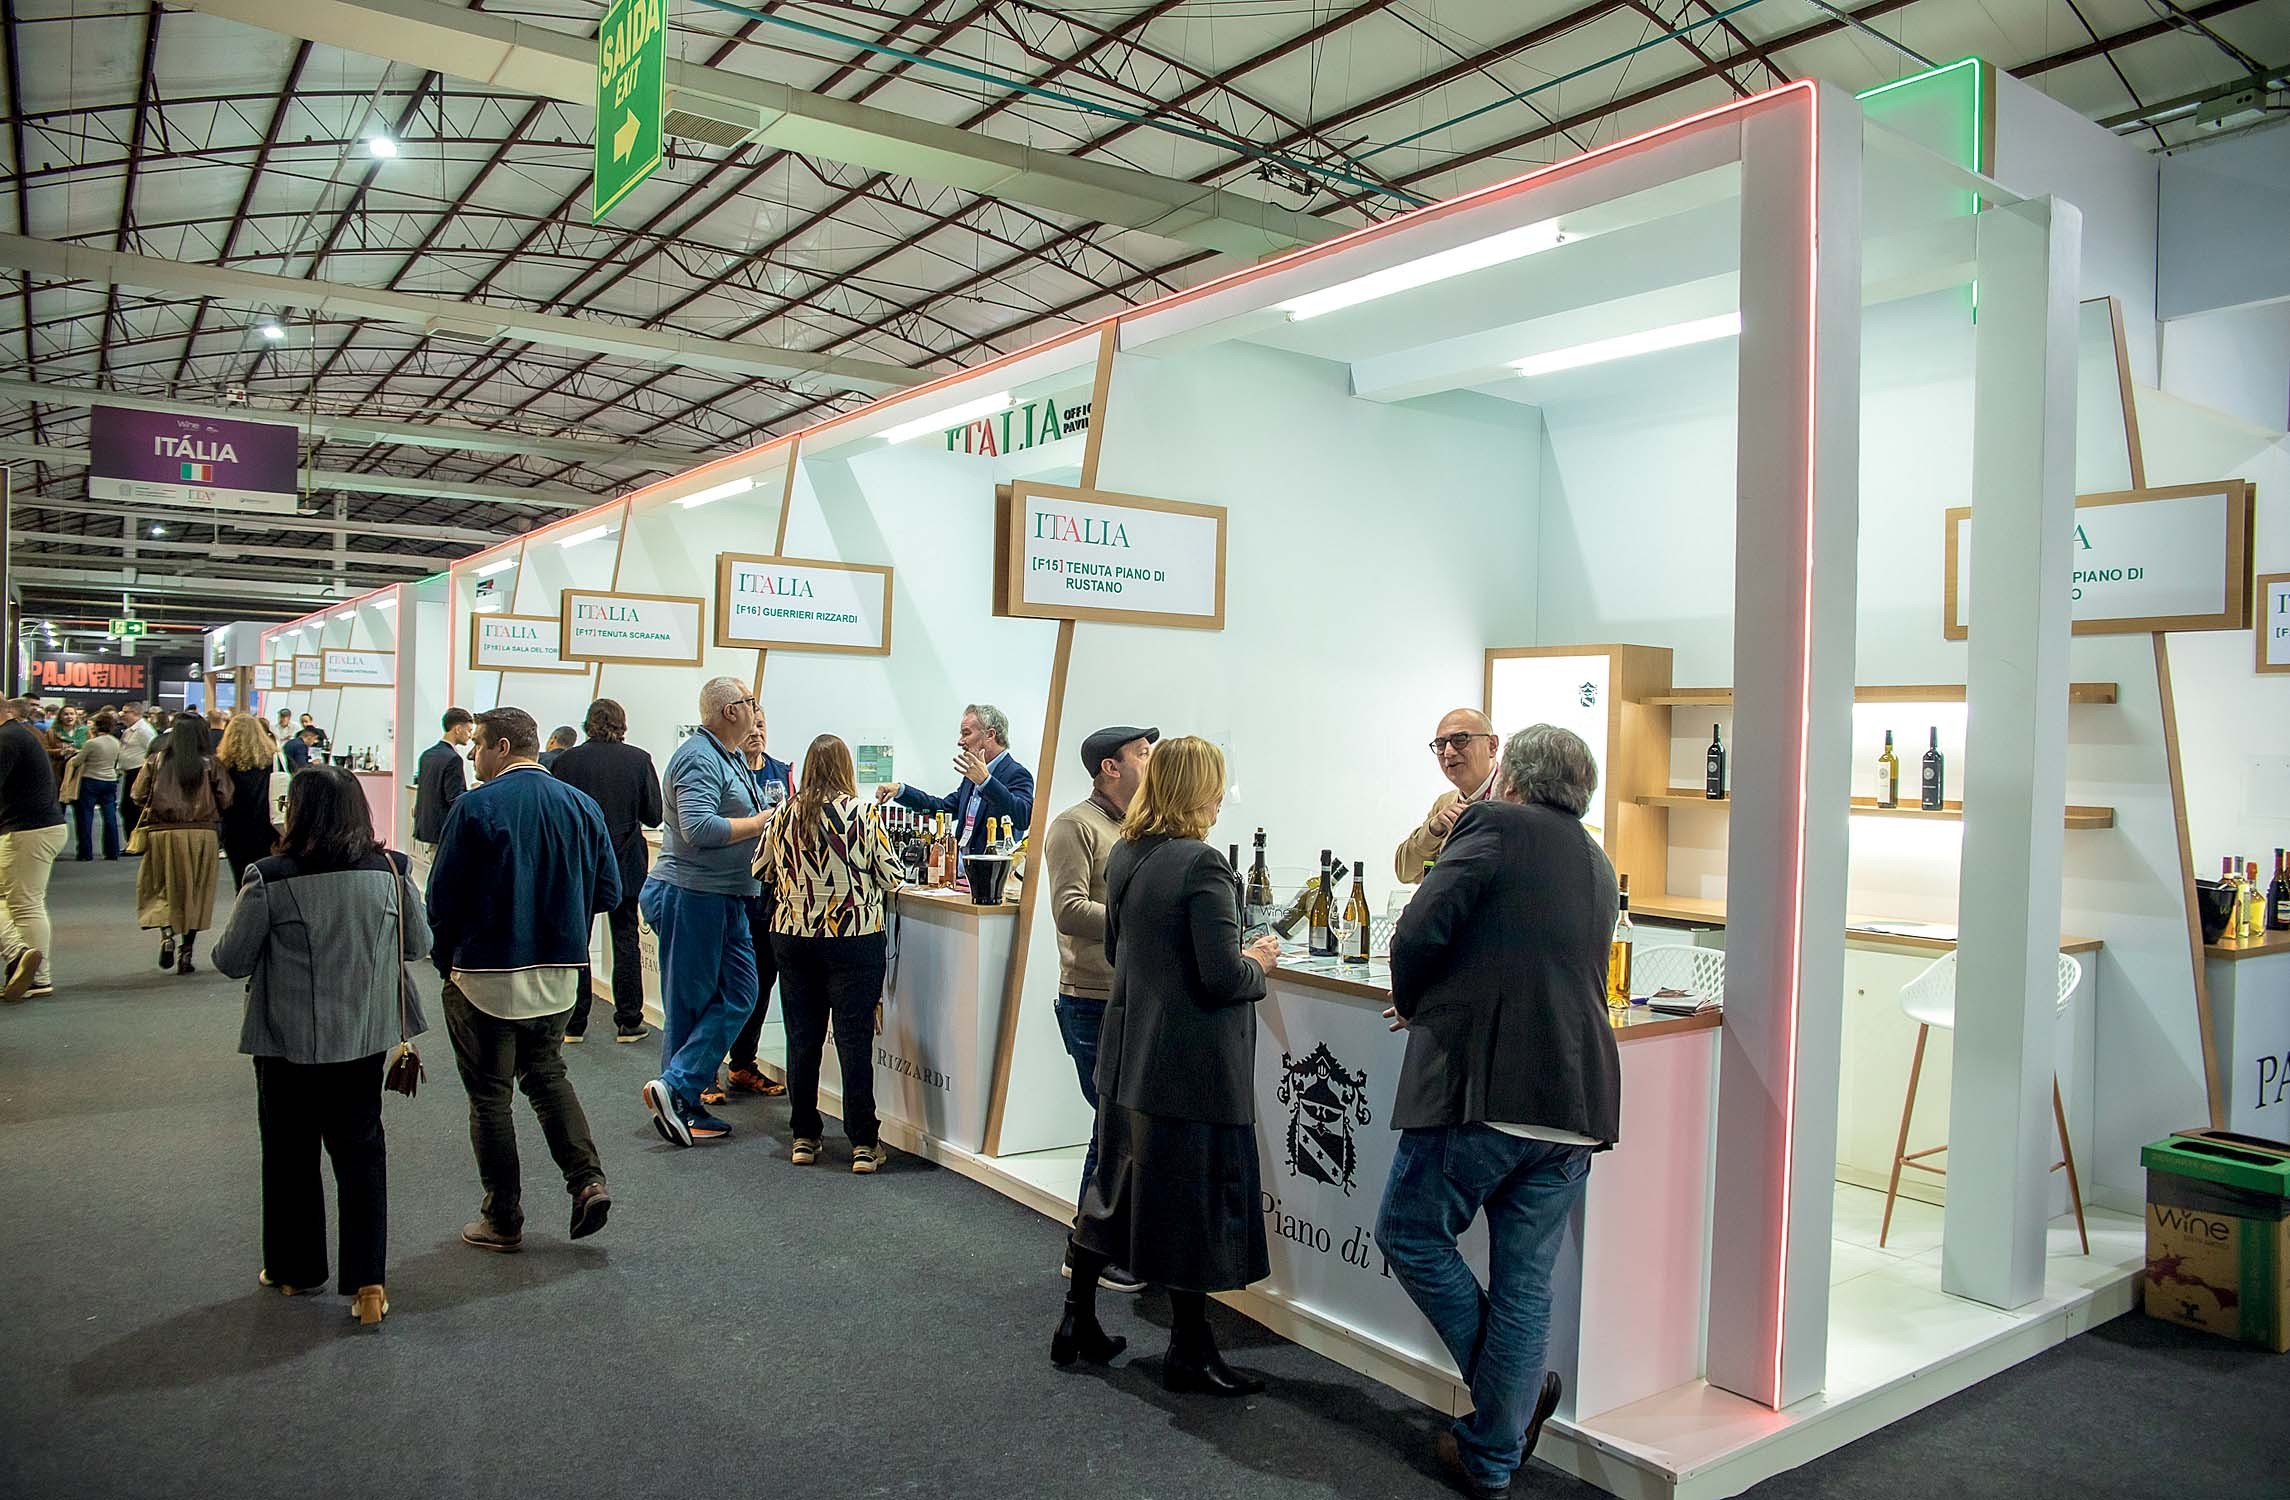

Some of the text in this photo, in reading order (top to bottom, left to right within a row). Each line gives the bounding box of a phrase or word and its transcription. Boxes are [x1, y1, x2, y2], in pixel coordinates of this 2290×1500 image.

[615, 56, 642, 109] EXIT
[944, 399, 1062, 457] ITALIA
[154, 434, 240, 464] ITÁLIA
[1034, 512, 1131, 548] ITALIA
[1032, 556, 1165, 582] [F15] TENUTA PIANO DI
[2072, 567, 2143, 583] PIANO DI
[738, 573, 814, 598] ITALIA
[1066, 577, 1123, 593] RUSTANO
[577, 604, 639, 622] ITALIA
[736, 603, 858, 623] [F16] GUERRIERI RIZZARDI
[485, 624, 537, 639] ITALIA
[575, 627, 670, 640] [F17] TENUTA SCRAFANA
[877, 1047, 952, 1092] RIZZARDI
[1262, 1191, 1331, 1253] Piano
[1341, 1226, 1370, 1269] di
[2154, 1203, 2230, 1241] Wine
